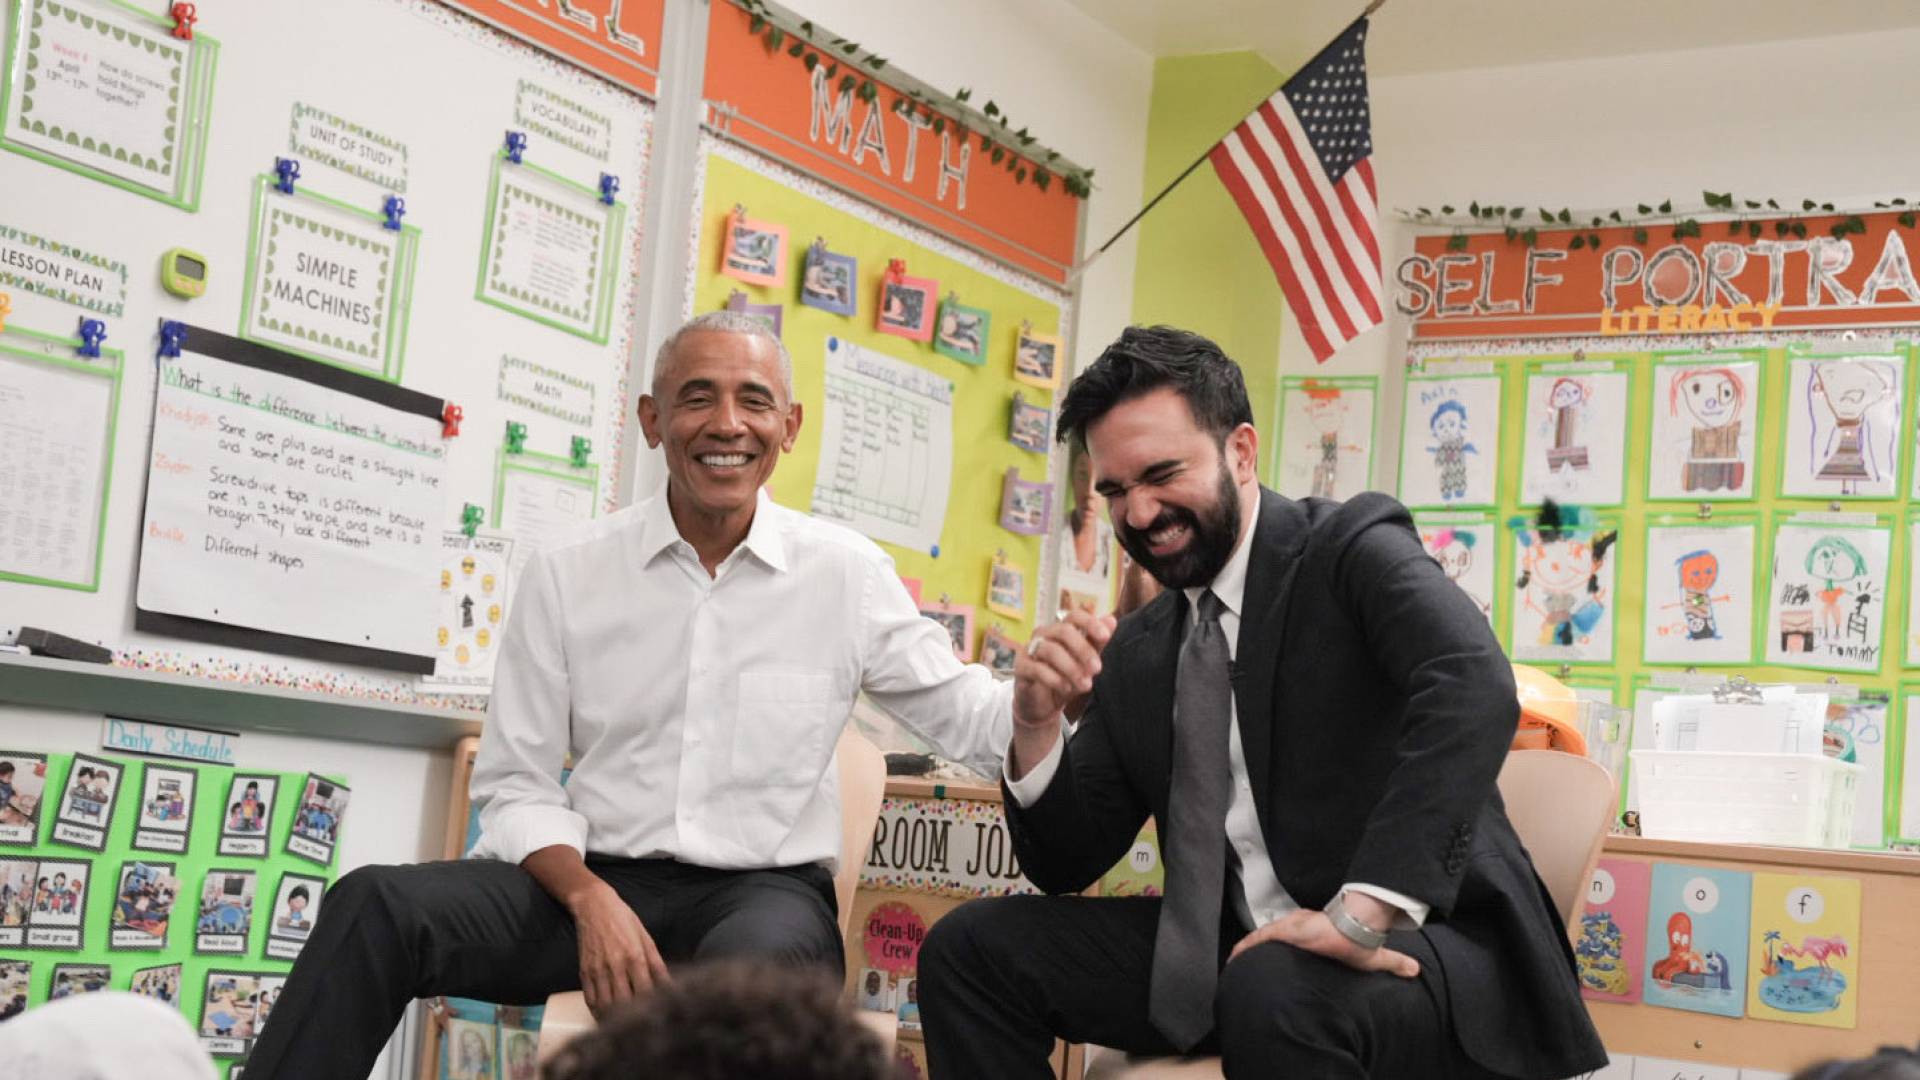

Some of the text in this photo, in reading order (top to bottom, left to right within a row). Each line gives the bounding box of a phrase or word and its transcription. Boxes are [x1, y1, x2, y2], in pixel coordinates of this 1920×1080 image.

[531, 101, 598, 138] VOCABULARY
[809, 62, 972, 211] MATH
[309, 125, 395, 167] UNIT OF STUDY
[1, 247, 104, 293] LESSON PLAN
[295, 251, 359, 290] SIMPLE
[1395, 246, 1568, 320] SELF
[273, 279, 372, 326] MACHINES
[162, 363, 202, 391] What
[210, 384, 223, 398] is
[230, 383, 252, 406] the
[258, 391, 317, 425] difference
[533, 381, 563, 400] MATH
[217, 438, 241, 455] and
[249, 446, 280, 464] some
[285, 455, 306, 469] are
[218, 414, 247, 438] Some
[255, 430, 276, 446] are
[281, 433, 307, 455] plus
[310, 444, 335, 461] and
[338, 453, 356, 467] are
[361, 459, 370, 471] a
[373, 460, 416, 486] straight
[236, 494, 248, 508] is
[256, 500, 267, 511] a
[345, 519, 368, 534] and
[373, 526, 394, 540] one
[397, 530, 408, 543] is
[413, 534, 423, 545] a
[319, 496, 330, 510] is
[333, 498, 382, 520] different
[204, 534, 261, 560] Different
[267, 550, 305, 572] shapes
[108, 718, 233, 760] Daily Schedule
[867, 815, 953, 874] ROOM
[1136, 850, 1150, 863] m
[1592, 879, 1603, 893] n
[1695, 889, 1706, 902] o
[1797, 893, 1812, 916] f
[869, 917, 924, 945] Clean-Up
[882, 940, 914, 960] Crew
